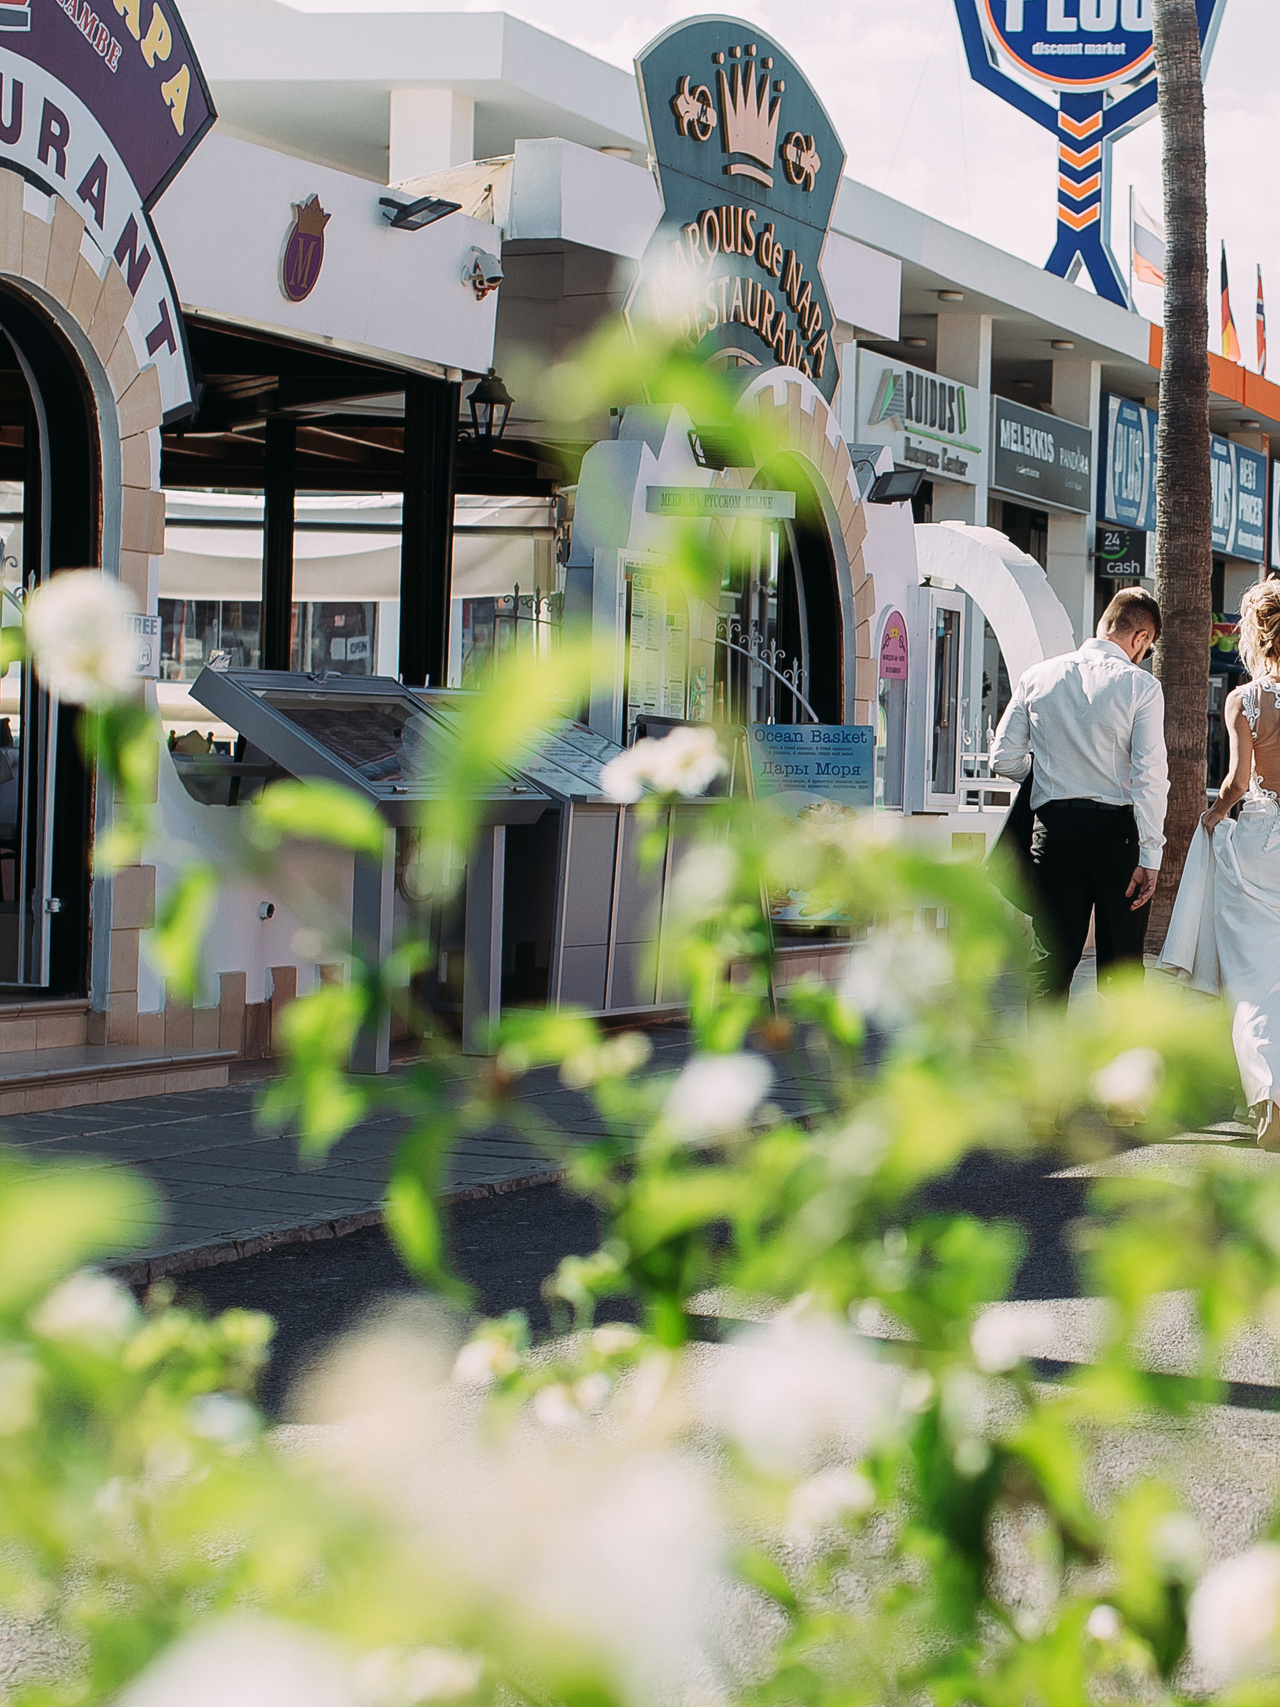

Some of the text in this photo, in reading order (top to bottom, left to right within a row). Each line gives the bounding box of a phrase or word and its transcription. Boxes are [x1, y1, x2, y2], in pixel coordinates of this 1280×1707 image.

[57, 0, 122, 73] AMBE
[1032, 42, 1126, 55] discount market
[756, 222, 783, 278] de
[779, 249, 829, 379] NAPA
[1000, 418, 1055, 464] MELEKKIS
[1115, 422, 1143, 503] PLUS
[704, 494, 741, 509] РУССКОМ
[1104, 532, 1120, 545] 24
[1106, 560, 1140, 574] cash
[755, 729, 868, 744] Ocean Basket
[760, 761, 861, 778] Дары Моря
